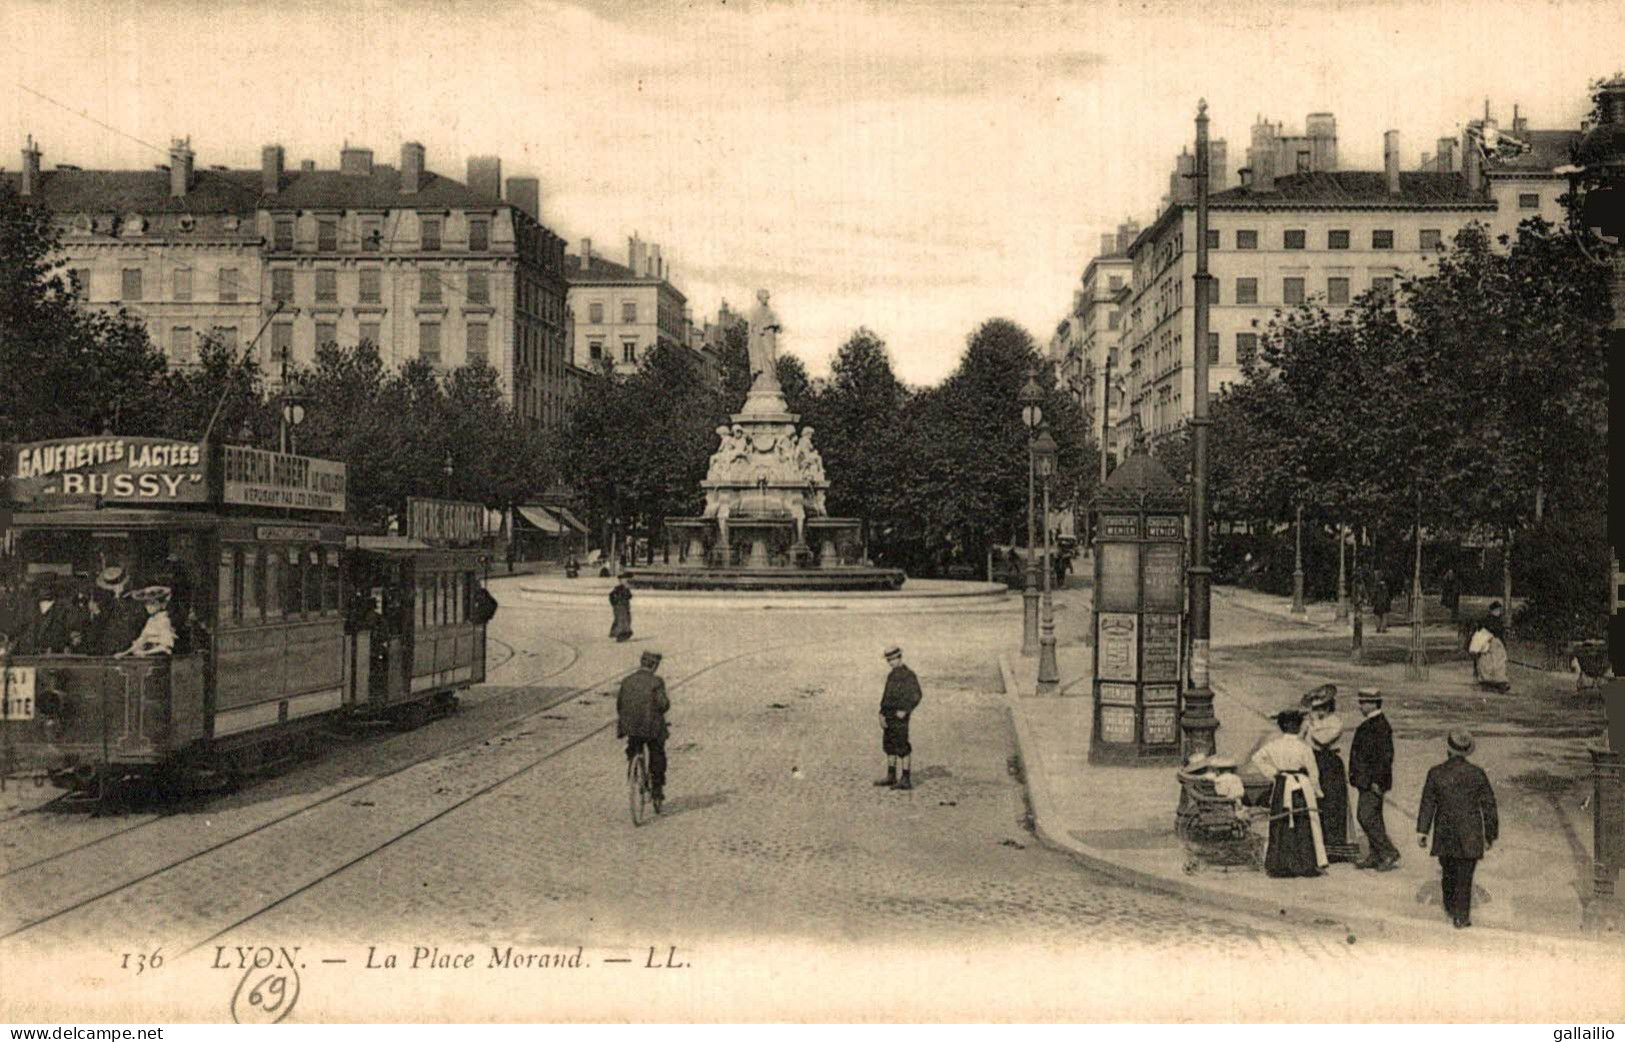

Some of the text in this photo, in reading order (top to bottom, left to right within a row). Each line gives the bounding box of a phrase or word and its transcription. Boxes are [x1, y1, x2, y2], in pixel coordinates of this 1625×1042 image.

[17, 440, 125, 479] GAUFRETTES
[1105, 518, 1137, 526] CHOCOLAT
[1147, 519, 1178, 527] CHOCOLAT
[1107, 527, 1135, 535] MENIER
[1149, 528, 1176, 536] MENIER
[248, 974, 288, 1012] 69
